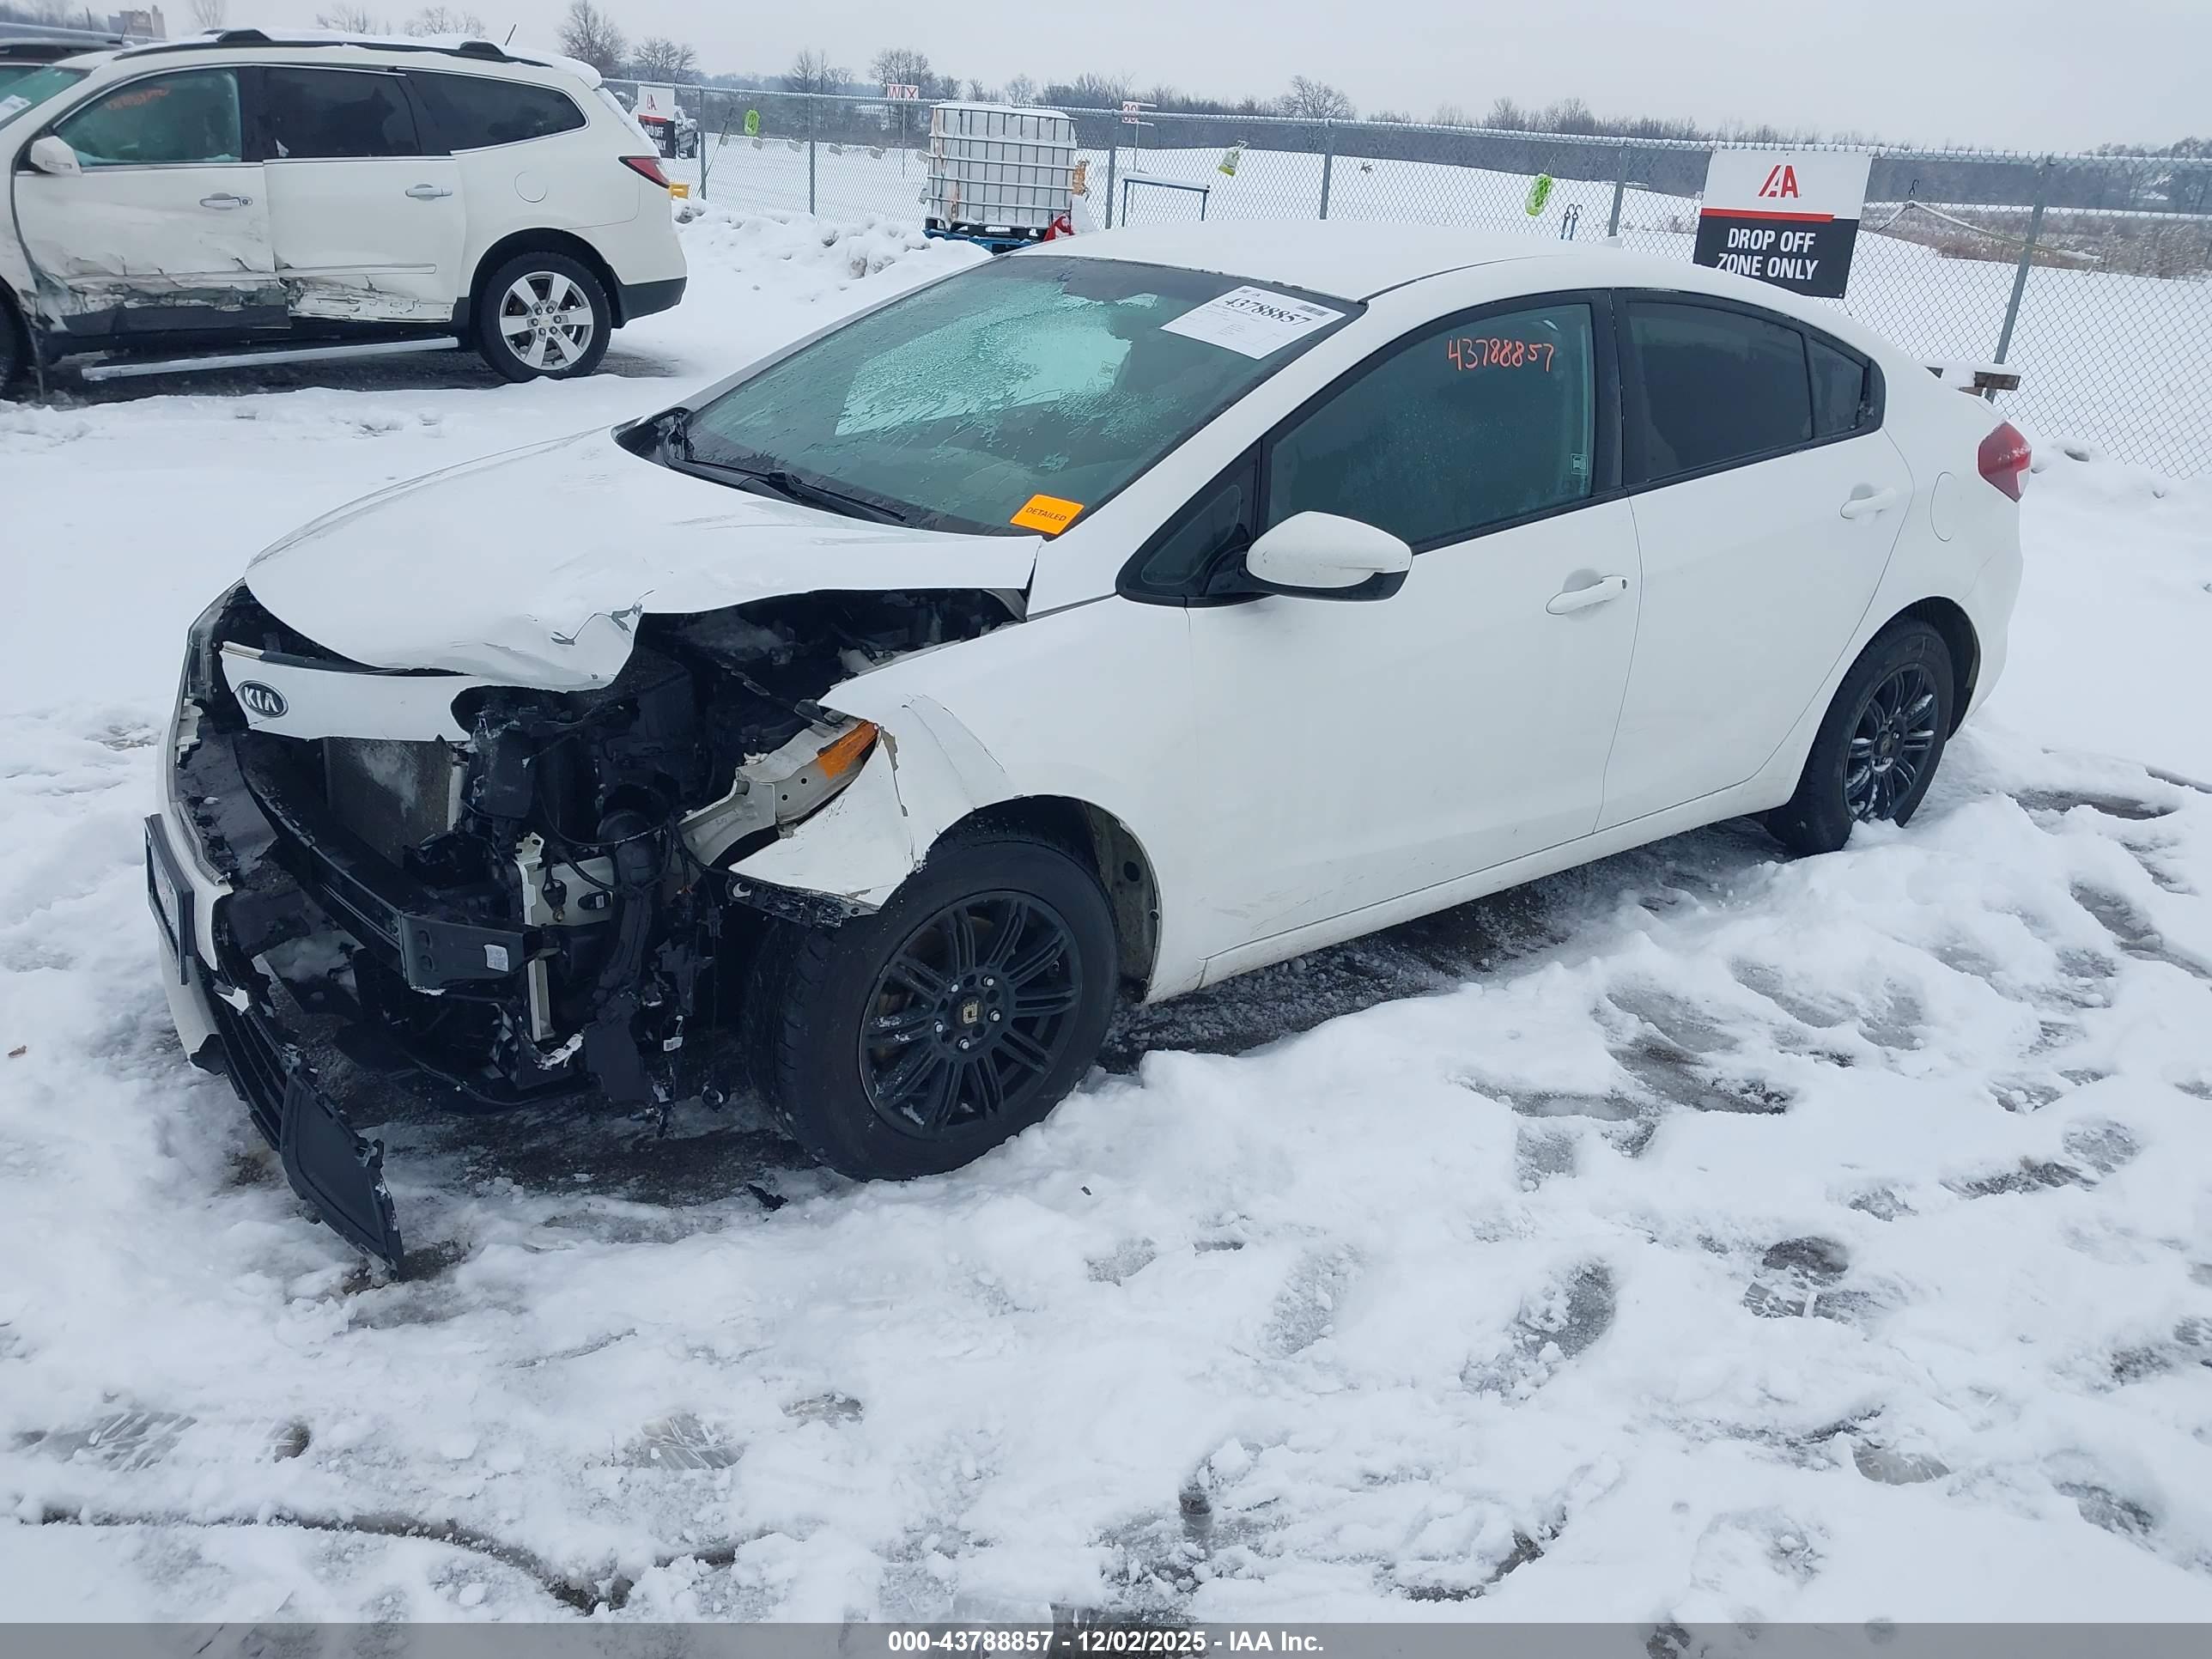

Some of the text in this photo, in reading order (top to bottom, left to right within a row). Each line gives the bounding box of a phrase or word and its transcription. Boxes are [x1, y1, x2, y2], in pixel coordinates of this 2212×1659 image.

[1727, 228, 1816, 253] DROP OFF
[1716, 252, 1819, 280] ZONE ONLY
[1224, 297, 1313, 326] 43788857
[1448, 337, 1555, 373] 43788857
[1025, 507, 1067, 522] DETAILED
[244, 686, 280, 713] KIA
